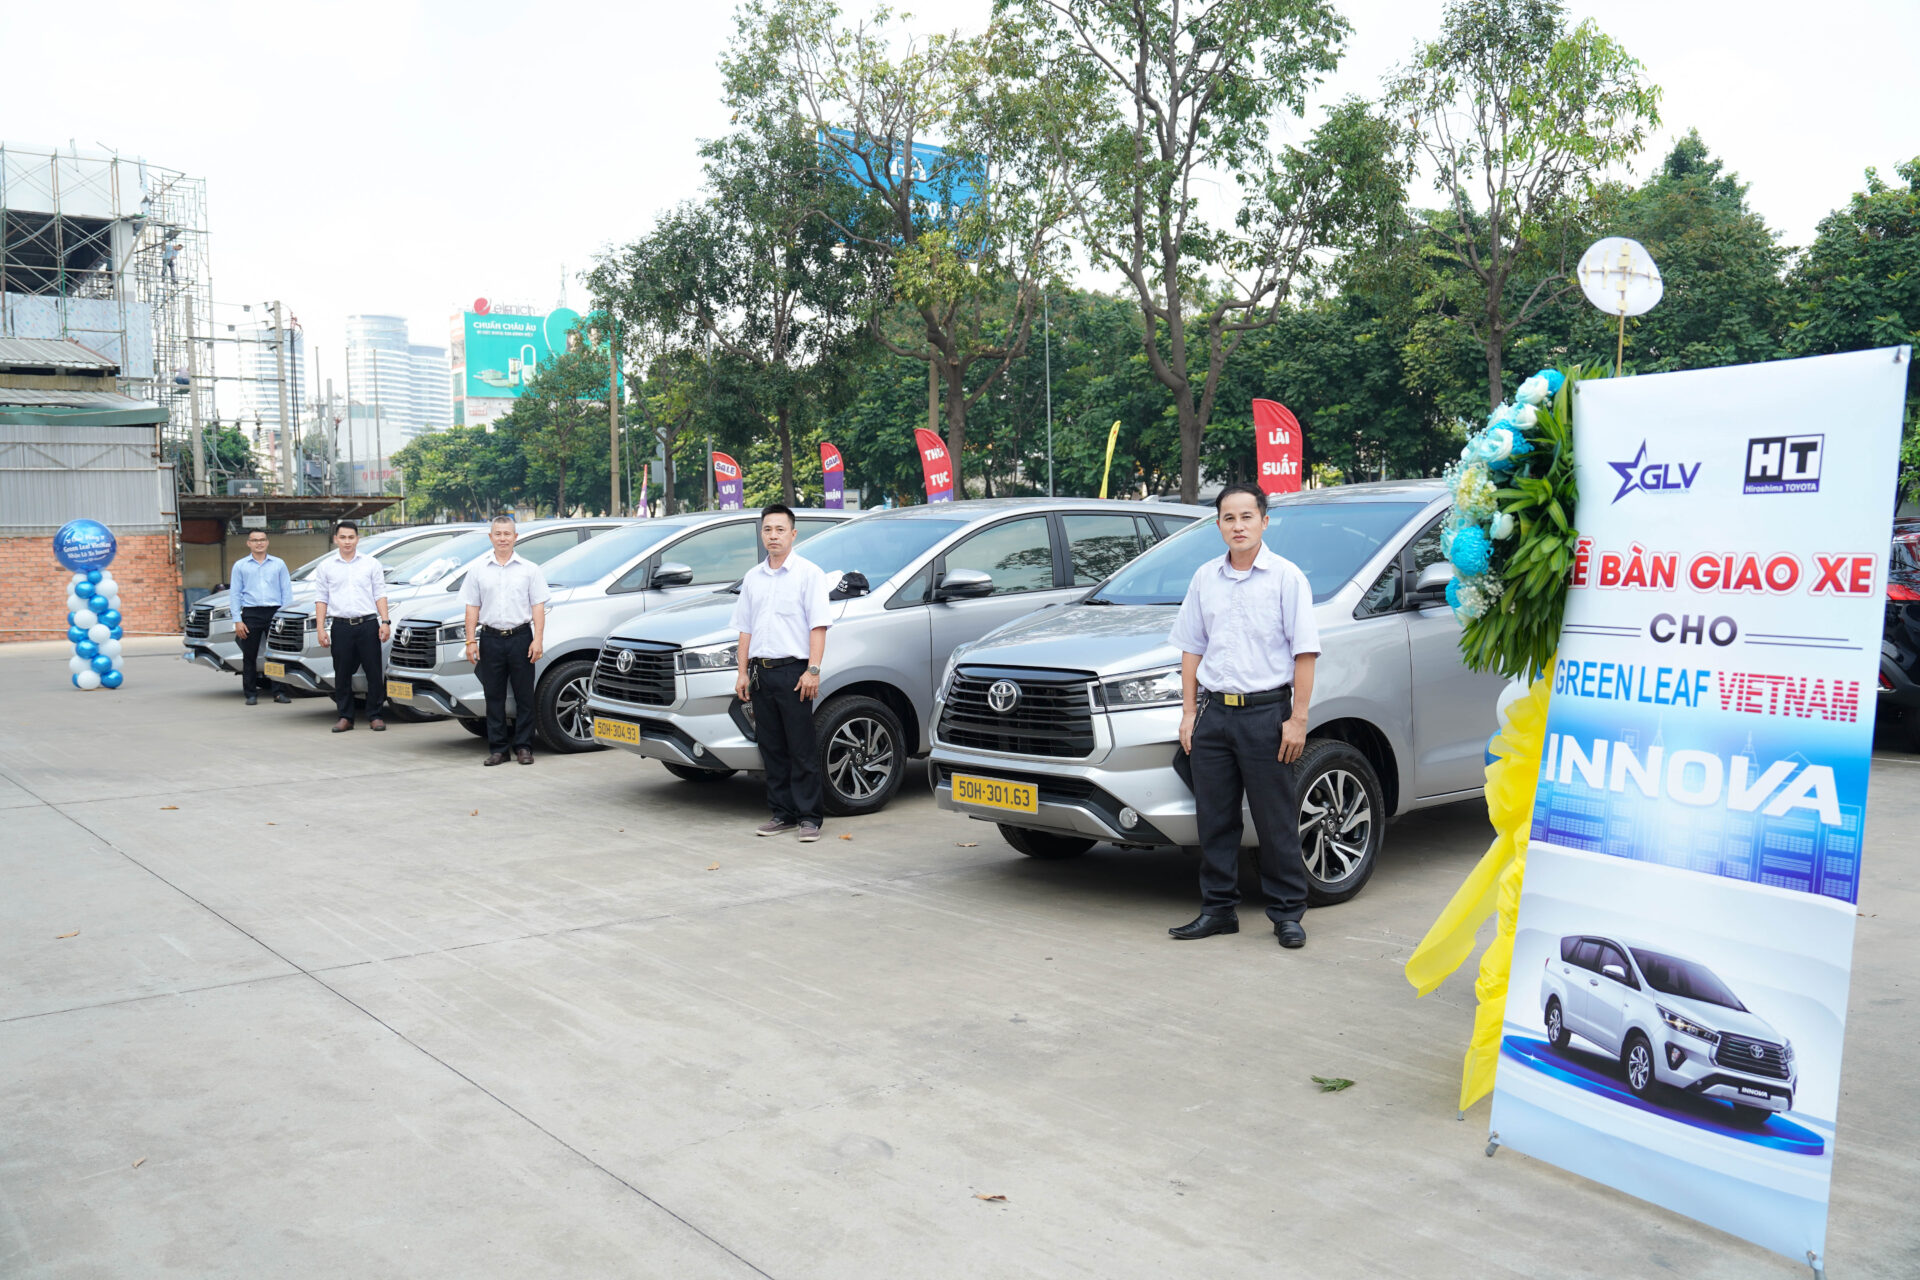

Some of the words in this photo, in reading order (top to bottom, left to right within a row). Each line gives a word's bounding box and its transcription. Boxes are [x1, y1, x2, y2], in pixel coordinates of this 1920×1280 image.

[1268, 427, 1290, 445] LÃI
[715, 462, 736, 475] SALE
[1262, 453, 1298, 475] SUẤT
[1749, 441, 1818, 477] HT
[930, 471, 950, 487] TỤC
[1640, 462, 1702, 489] GLV
[1745, 484, 1784, 494] Hiroshima
[1785, 482, 1817, 492] TOYOTA
[1567, 540, 1591, 586] Ễ
[1600, 546, 1677, 588] BÀN
[1690, 556, 1799, 590] GIAO
[1812, 557, 1873, 593] XE
[1650, 613, 1738, 646] CHO
[1555, 659, 1634, 701] GREEN
[1637, 666, 1711, 708] LEAF
[1718, 671, 1860, 723] VIETNAM
[1545, 733, 1842, 826] INNOVA
[1741, 1086, 1769, 1098] INNOVA
